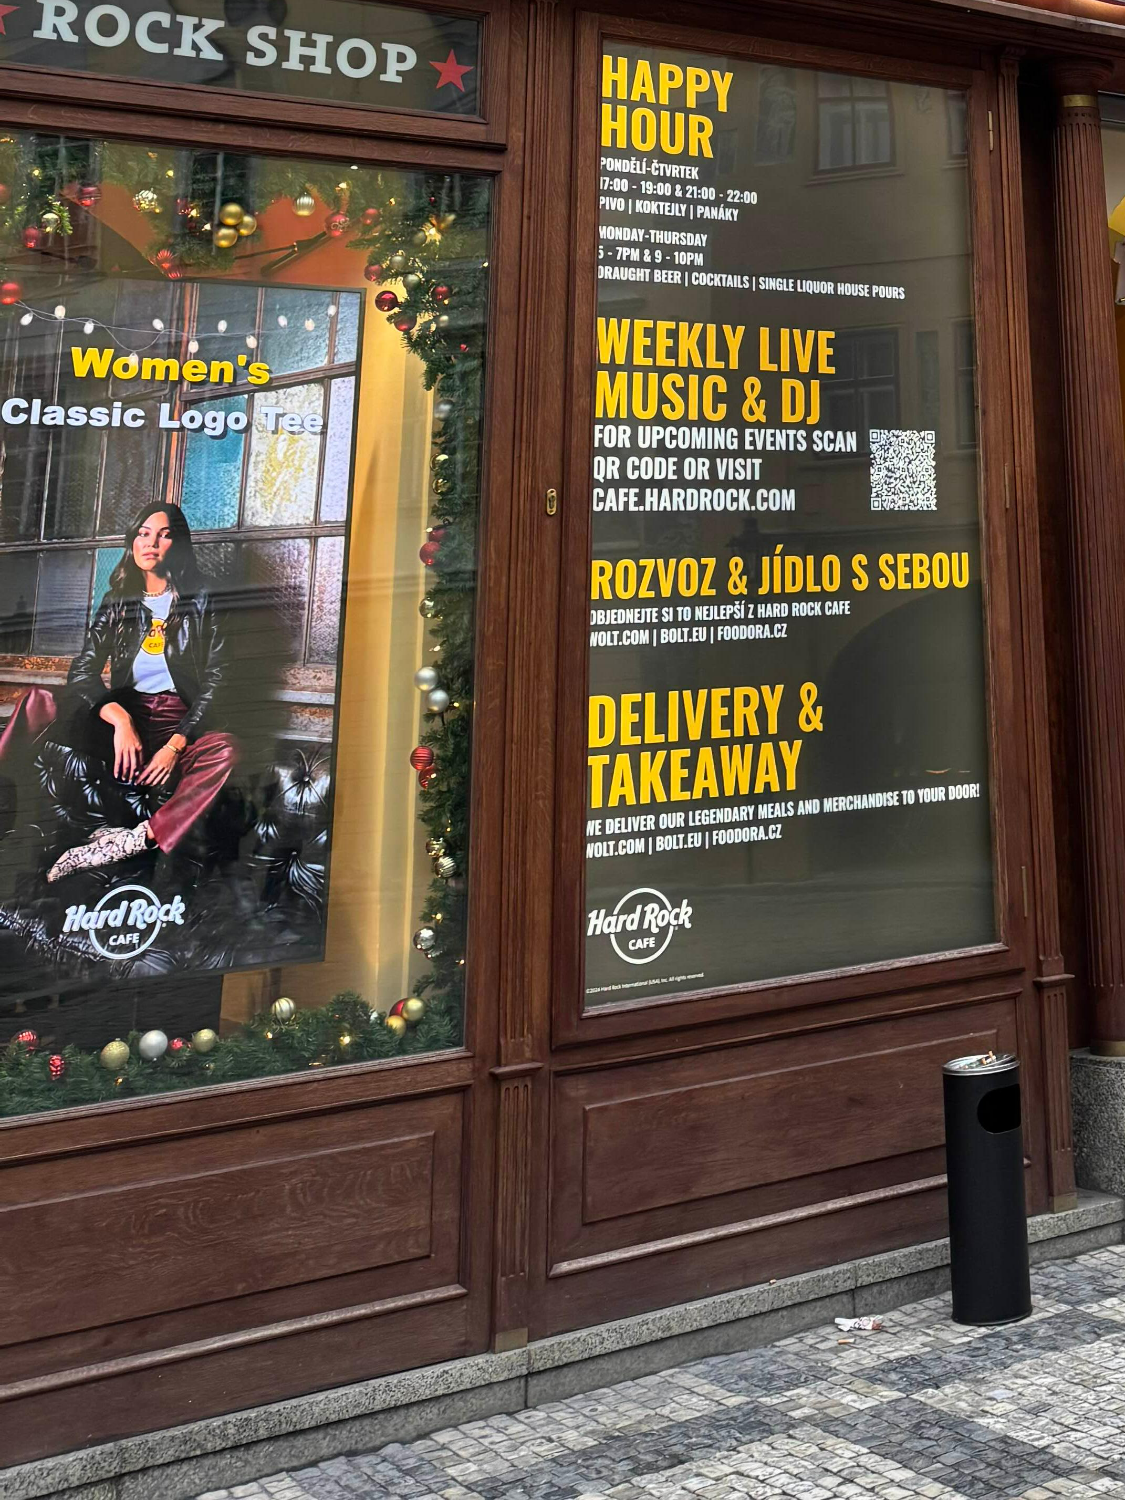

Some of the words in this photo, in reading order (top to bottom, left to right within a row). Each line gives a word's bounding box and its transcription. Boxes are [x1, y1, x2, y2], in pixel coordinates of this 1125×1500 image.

[245, 25, 417, 84] SHOP
[602, 55, 734, 112] HAPPY
[601, 103, 714, 158] HOUR
[599, 196, 625, 213] PIVO
[635, 199, 686, 220] KOKTEJLY
[697, 202, 739, 222] PANÁKY
[640, 179, 672, 197] 19:00
[675, 183, 683, 197] &
[685, 184, 716, 201] 21:00
[726, 188, 758, 205] 22:00
[598, 225, 708, 247] MONDAY-THURSDAY
[615, 246, 640, 262] 7PM
[643, 247, 652, 263] &
[654, 249, 662, 264] 9
[673, 250, 704, 267] 10PM
[597, 265, 651, 284] DRAUGHT
[653, 268, 681, 285] BEER
[691, 271, 749, 289] COCKTAILS
[758, 276, 794, 292] SINGLE
[796, 278, 835, 296] LIQUOR
[837, 281, 869, 297] HOUSE
[871, 283, 905, 299] POURS
[596, 317, 745, 370] WEEKLY
[759, 326, 836, 374] LIVE
[70, 346, 271, 385] Women's
[594, 370, 727, 422] MUSIC
[742, 377, 767, 423] &
[781, 378, 821, 425] DJ
[2, 397, 146, 429] Classic
[159, 401, 248, 436] Logo
[261, 405, 324, 434] Tee
[593, 424, 631, 449] FOR
[637, 427, 739, 451] UPCOMING
[744, 429, 808, 452] EVENTS
[812, 430, 857, 453] SCAN
[593, 456, 620, 481] QR
[626, 457, 678, 481] CODE
[683, 457, 710, 480] OR
[716, 458, 762, 481] VISIT
[592, 488, 796, 512] CAFE.HARDROCK.COM
[591, 558, 716, 600] ROZVOZ
[728, 556, 748, 596] &
[758, 544, 841, 596] JÍDLO
[851, 553, 870, 591] S
[878, 552, 970, 591] SEBOU
[661, 606, 673, 622] SI
[676, 605, 692, 622] TO
[694, 600, 746, 622] NEJLEPŠÍ
[748, 604, 754, 619] Z
[757, 603, 789, 619] HARD
[791, 601, 822, 617] ROCK
[825, 600, 851, 616] CAFE
[660, 627, 707, 645] BOLT.EU
[717, 623, 787, 642] FOODORA.CZ
[588, 683, 785, 749] DELIVERY
[798, 681, 824, 732] &
[587, 739, 803, 810] TAKEAWAY
[605, 815, 656, 835] DELIVER
[659, 812, 685, 830] OUR
[688, 805, 754, 829] LEGENDARY
[758, 802, 794, 820] MEALS
[797, 799, 820, 817] AND
[823, 791, 899, 816] MERCHANDISE
[901, 790, 914, 805] TO
[918, 787, 946, 803] YOUR
[948, 783, 980, 801] DOOR!
[655, 833, 702, 852] BOLT.EU
[712, 824, 782, 846] FOODORA.CZ
[62, 900, 129, 933] Hard
[129, 894, 186, 930] Rock
[587, 906, 642, 937] Hard
[643, 899, 693, 935] Rock
[109, 933, 140, 946] CAFE
[628, 937, 656, 950] CAFE
